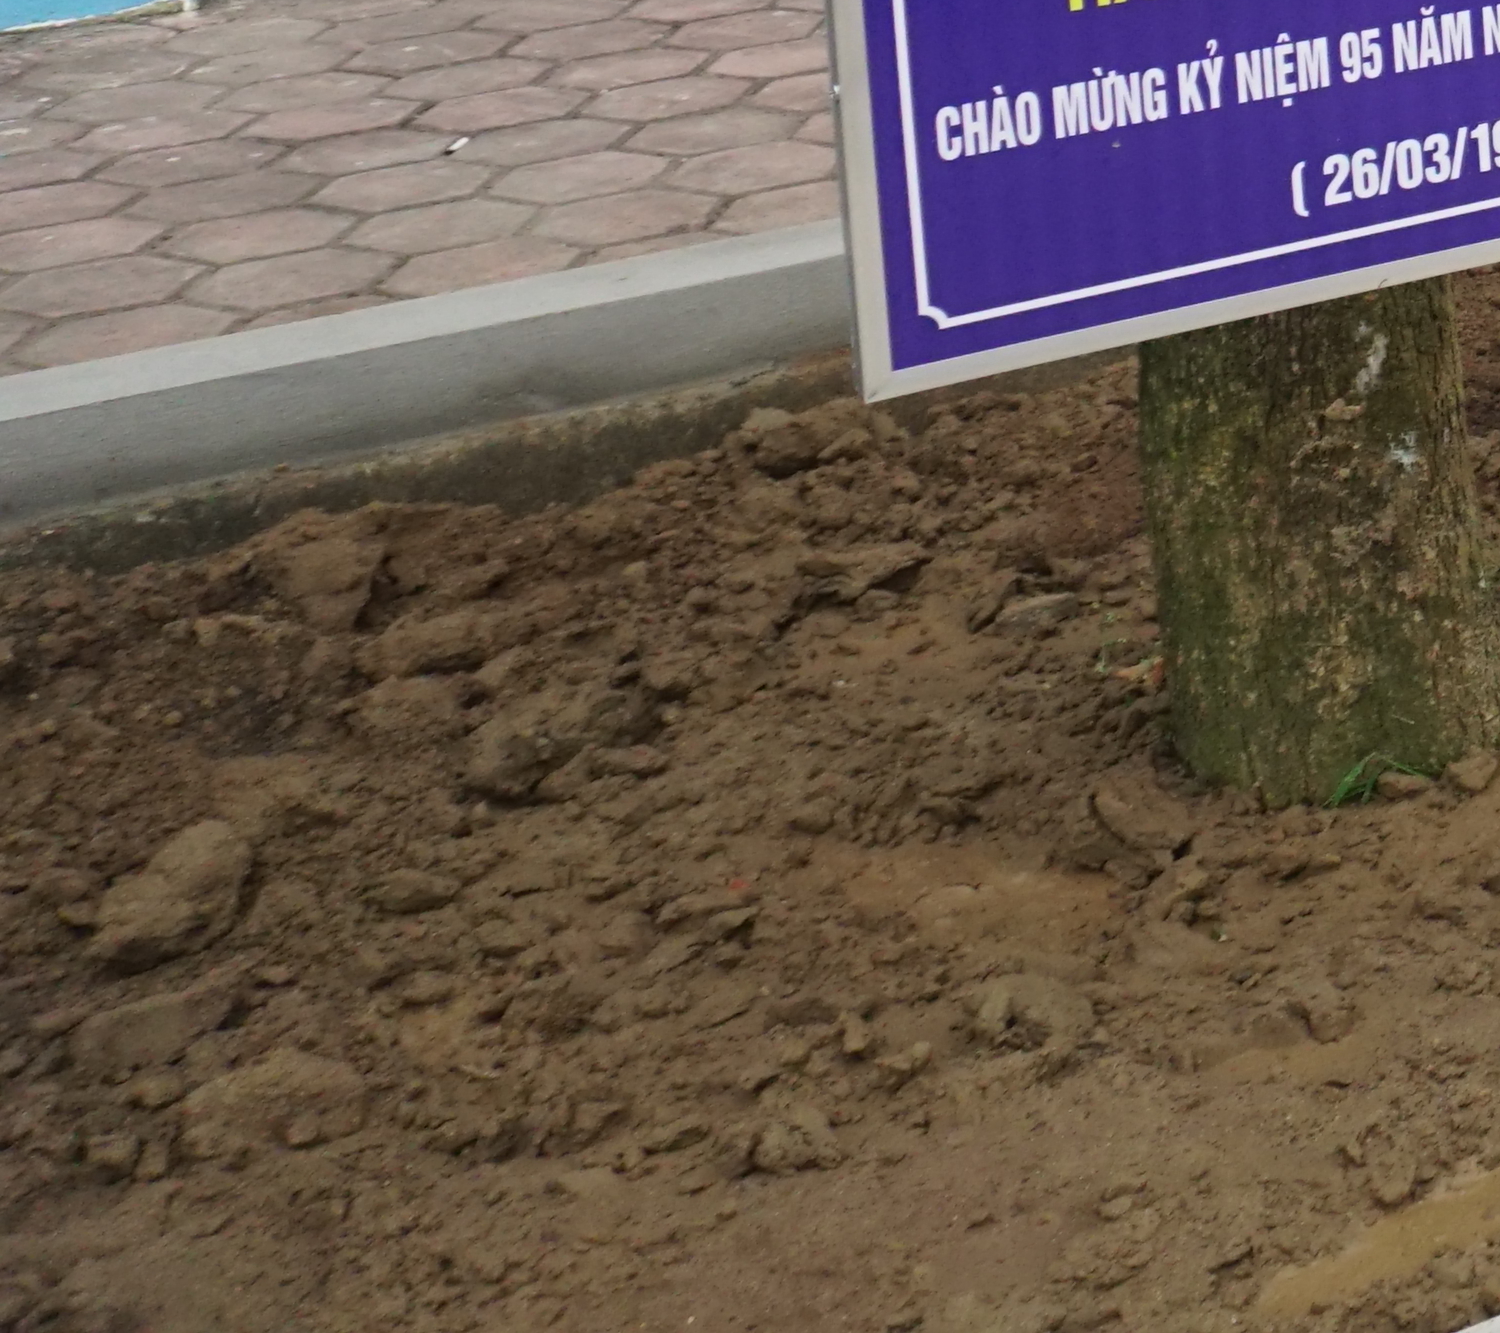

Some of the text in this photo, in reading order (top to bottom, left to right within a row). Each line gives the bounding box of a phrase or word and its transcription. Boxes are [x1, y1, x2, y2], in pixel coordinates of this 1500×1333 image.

[935, 85, 1041, 162] CHÀO
[1052, 66, 1168, 140] MỪNG
[1177, 39, 1224, 115] KỶ
[1235, 33, 1331, 109] NIỆM
[1339, 27, 1383, 84] 95
[1392, 5, 1472, 74] NĂM
